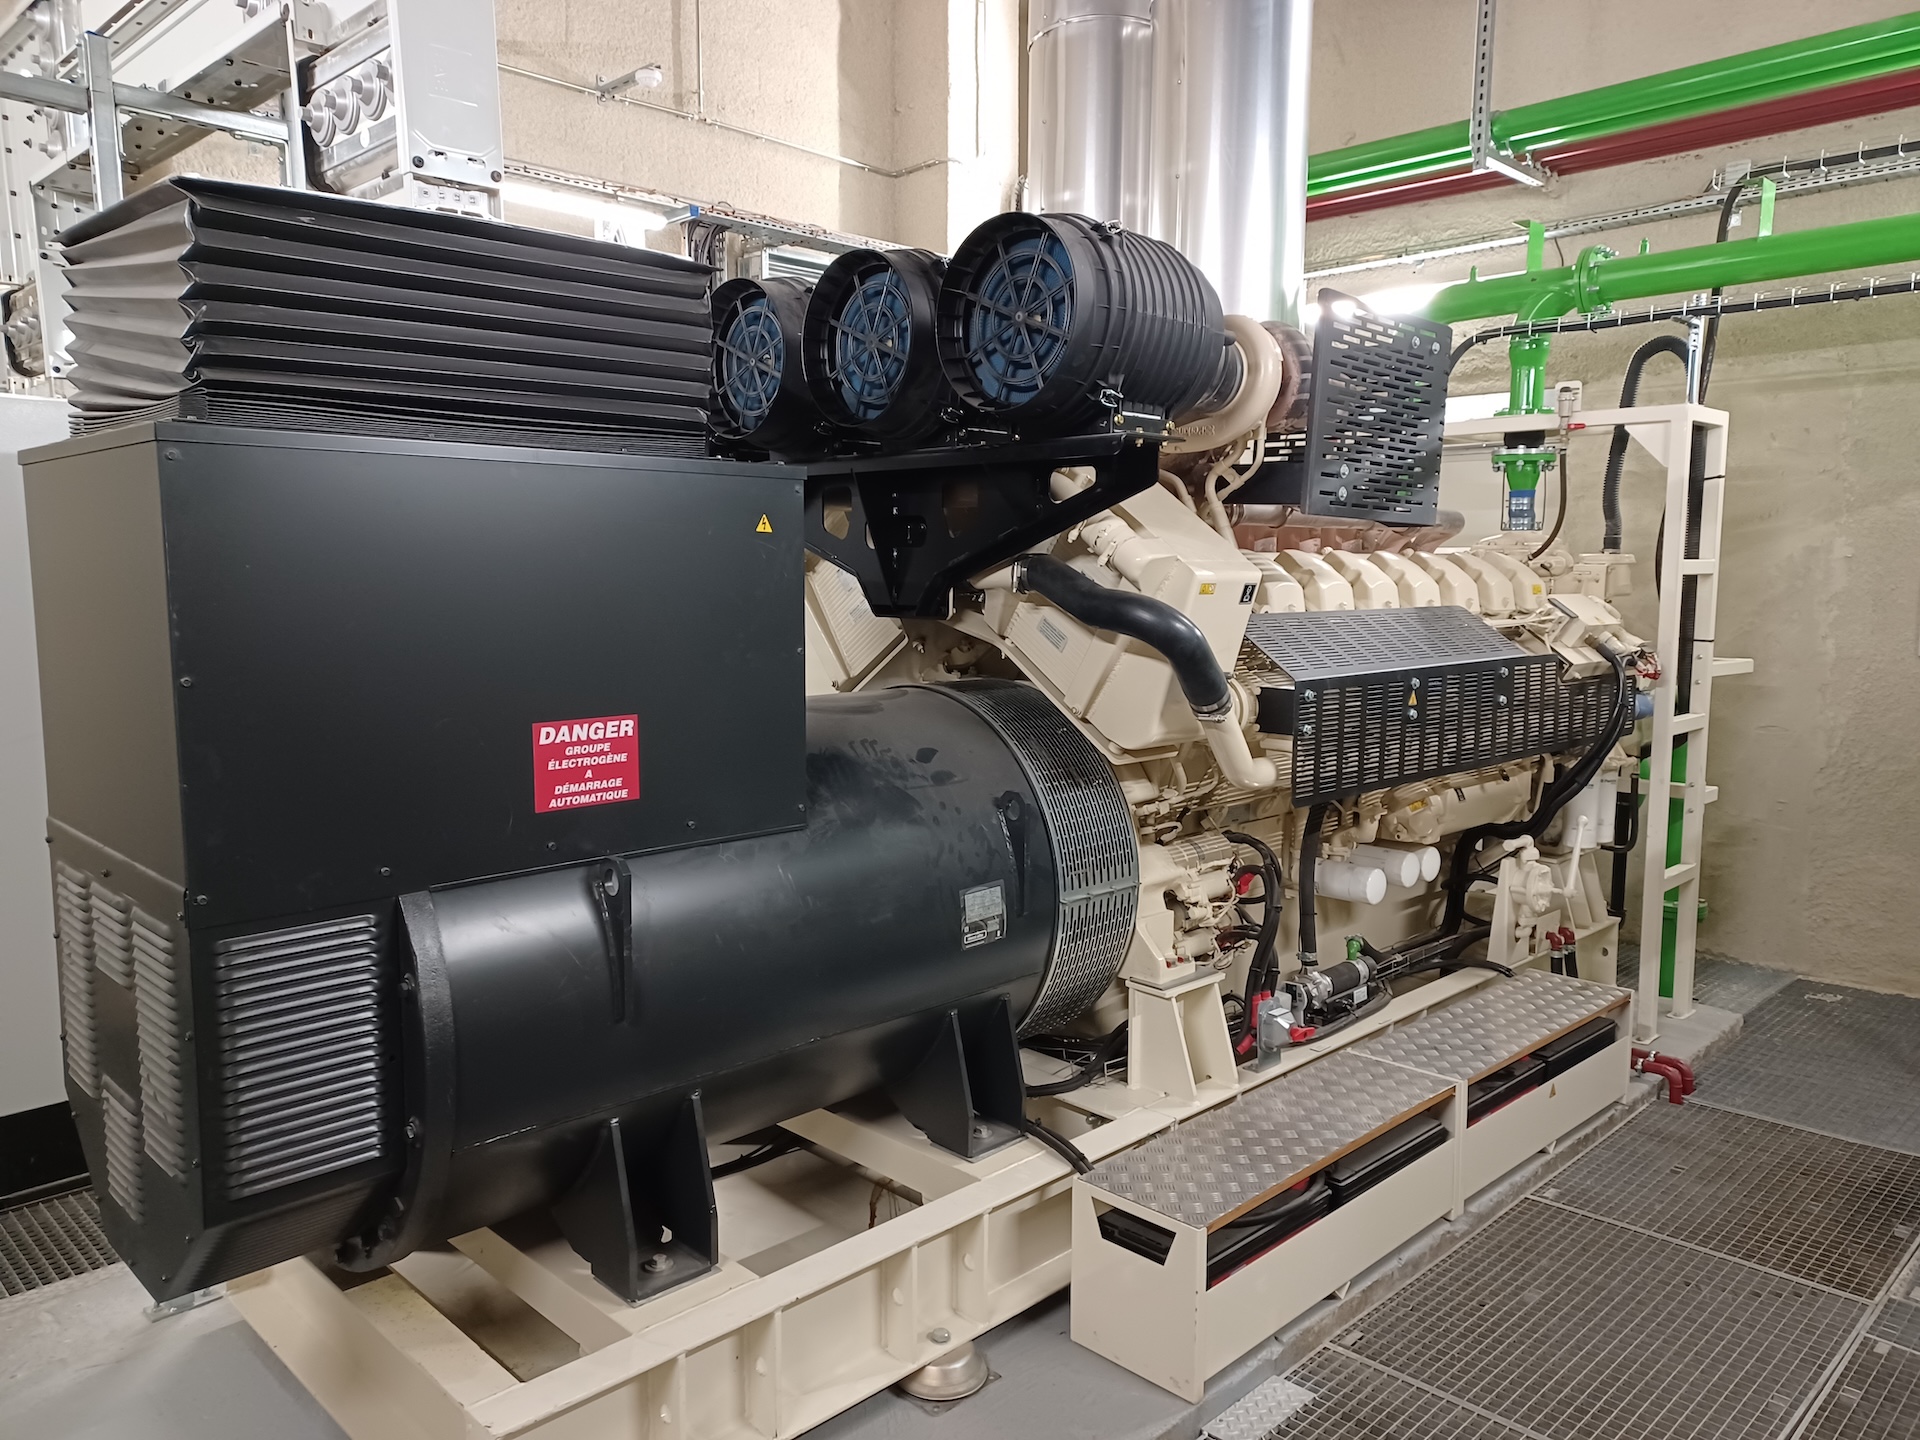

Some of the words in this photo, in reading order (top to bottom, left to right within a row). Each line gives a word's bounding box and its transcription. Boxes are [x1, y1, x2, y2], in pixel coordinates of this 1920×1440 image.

[539, 719, 634, 745] DANGER
[565, 743, 610, 755] GROUPE
[548, 753, 627, 770] ÉLECTROGÈNE
[584, 769, 593, 779] A
[555, 778, 622, 795] DÉMARRAGE
[549, 789, 628, 808] AUTOMATIQUE
